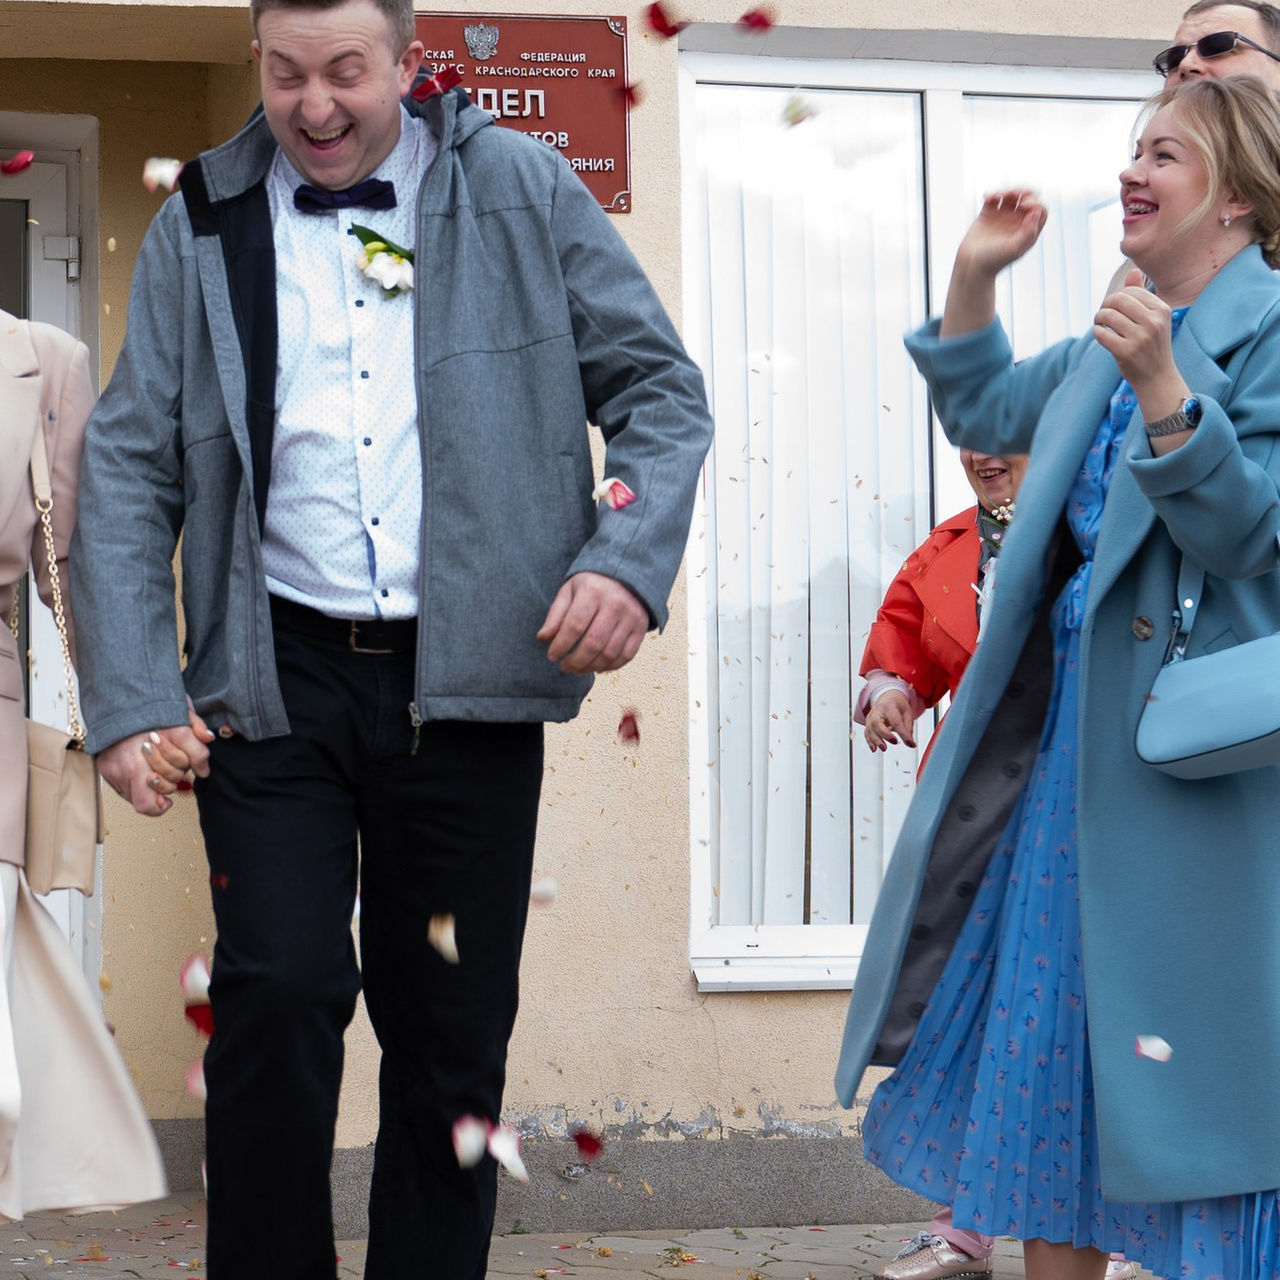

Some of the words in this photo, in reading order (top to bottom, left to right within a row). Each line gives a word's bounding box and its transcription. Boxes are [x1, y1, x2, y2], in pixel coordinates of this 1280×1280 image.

[423, 50, 454, 59] СКАЯ
[520, 52, 586, 63] ФЕДЕРАЦИЯ
[475, 66, 579, 77] КРАСНОДАРСКОГО
[587, 68, 616, 78] КРАЯ
[464, 88, 545, 118] ДЕЛ
[522, 131, 569, 148] ТОВ
